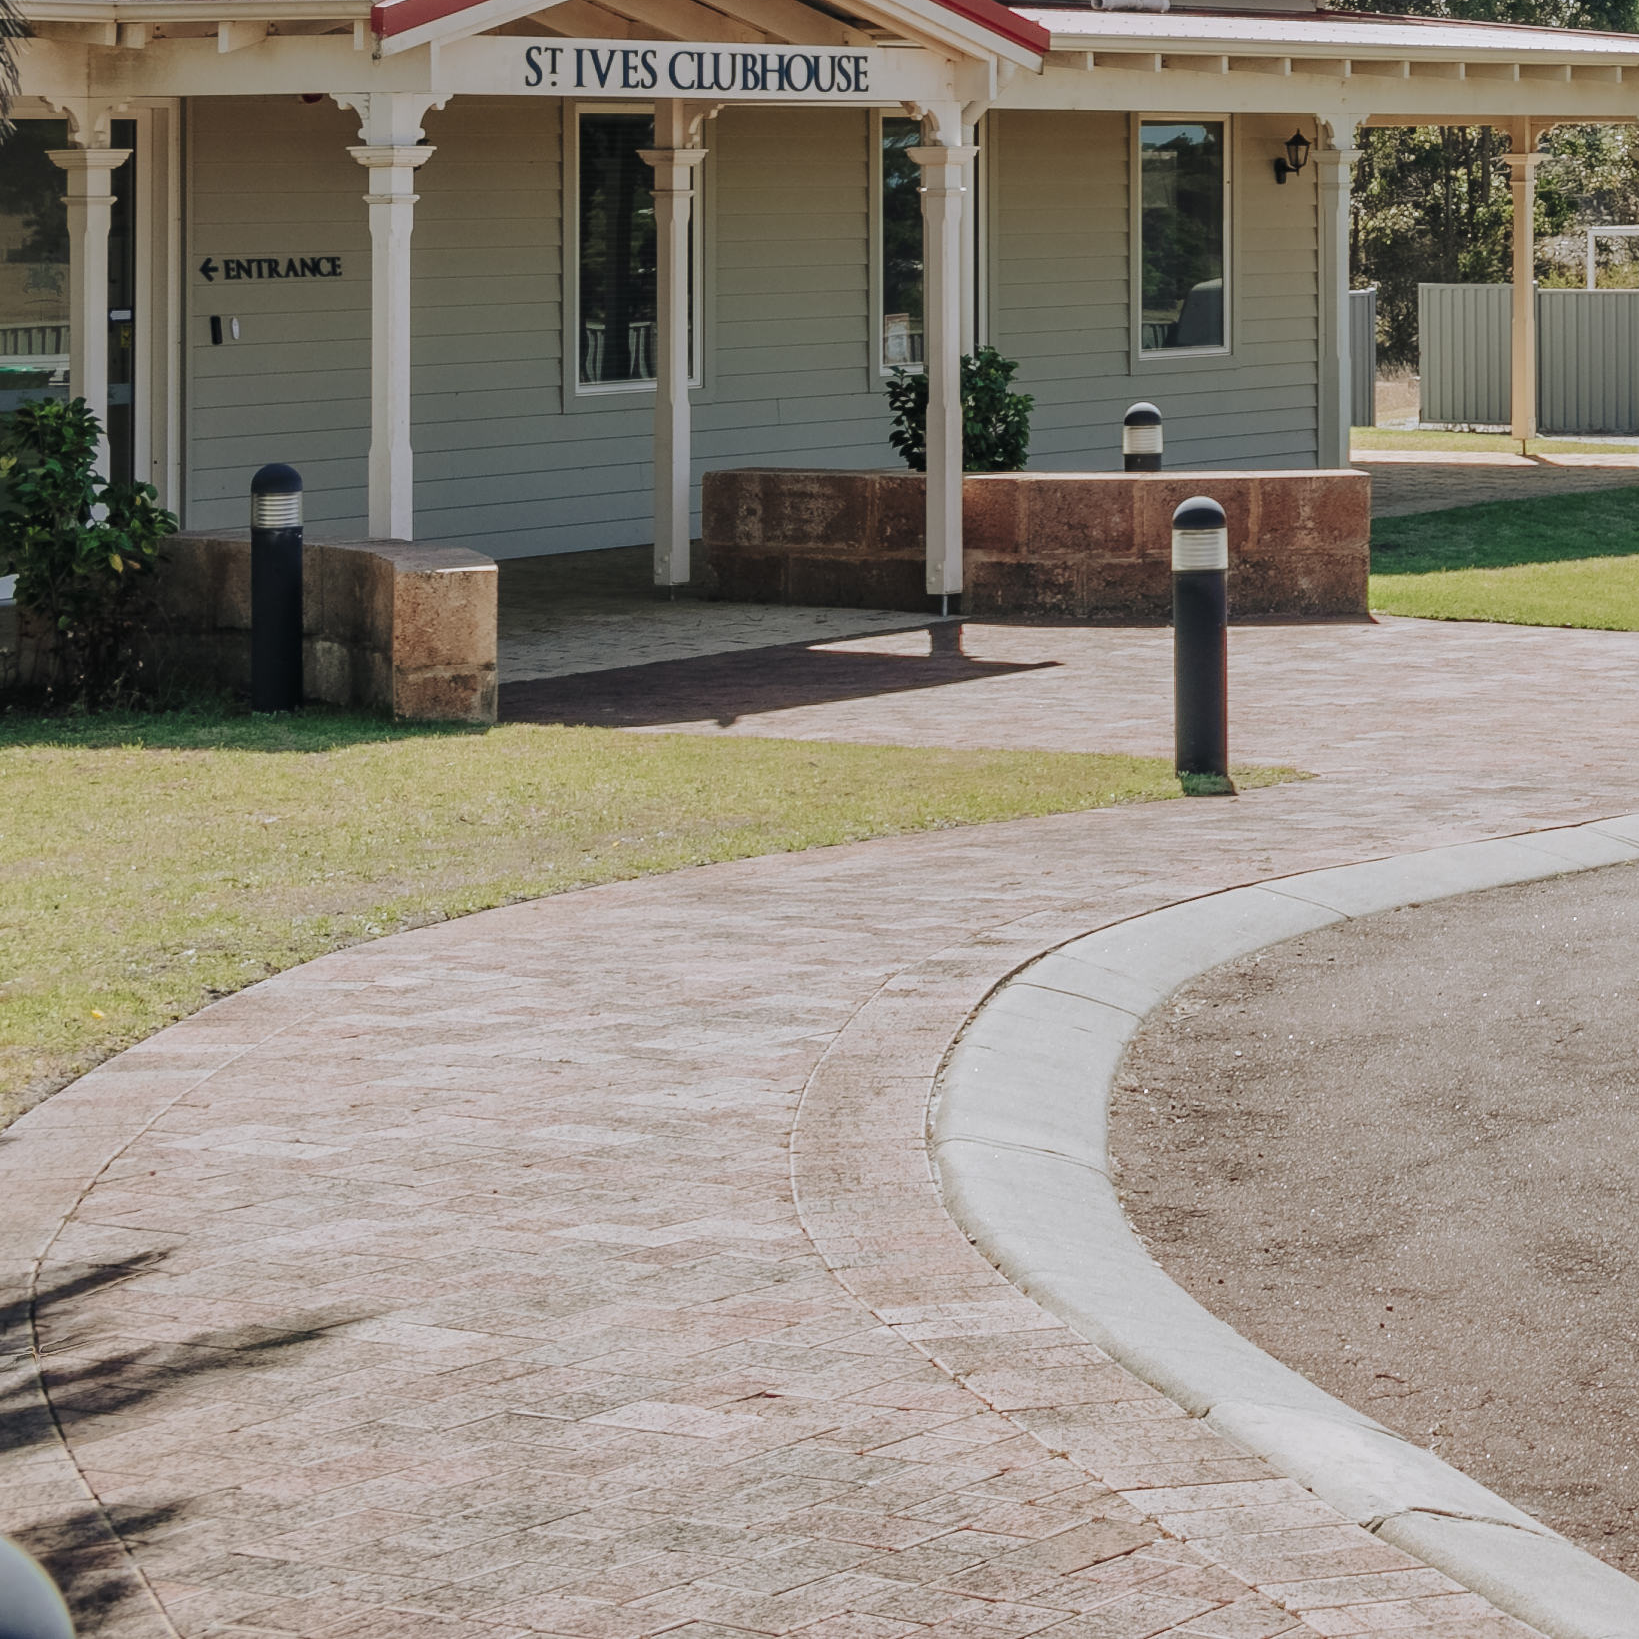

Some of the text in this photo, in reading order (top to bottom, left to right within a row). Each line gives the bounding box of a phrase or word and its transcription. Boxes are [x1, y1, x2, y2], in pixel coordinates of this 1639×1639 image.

[574, 48, 657, 89] IVES
[669, 51, 869, 92] CLUBHOUSE
[222, 257, 343, 280] ENTRANCE
